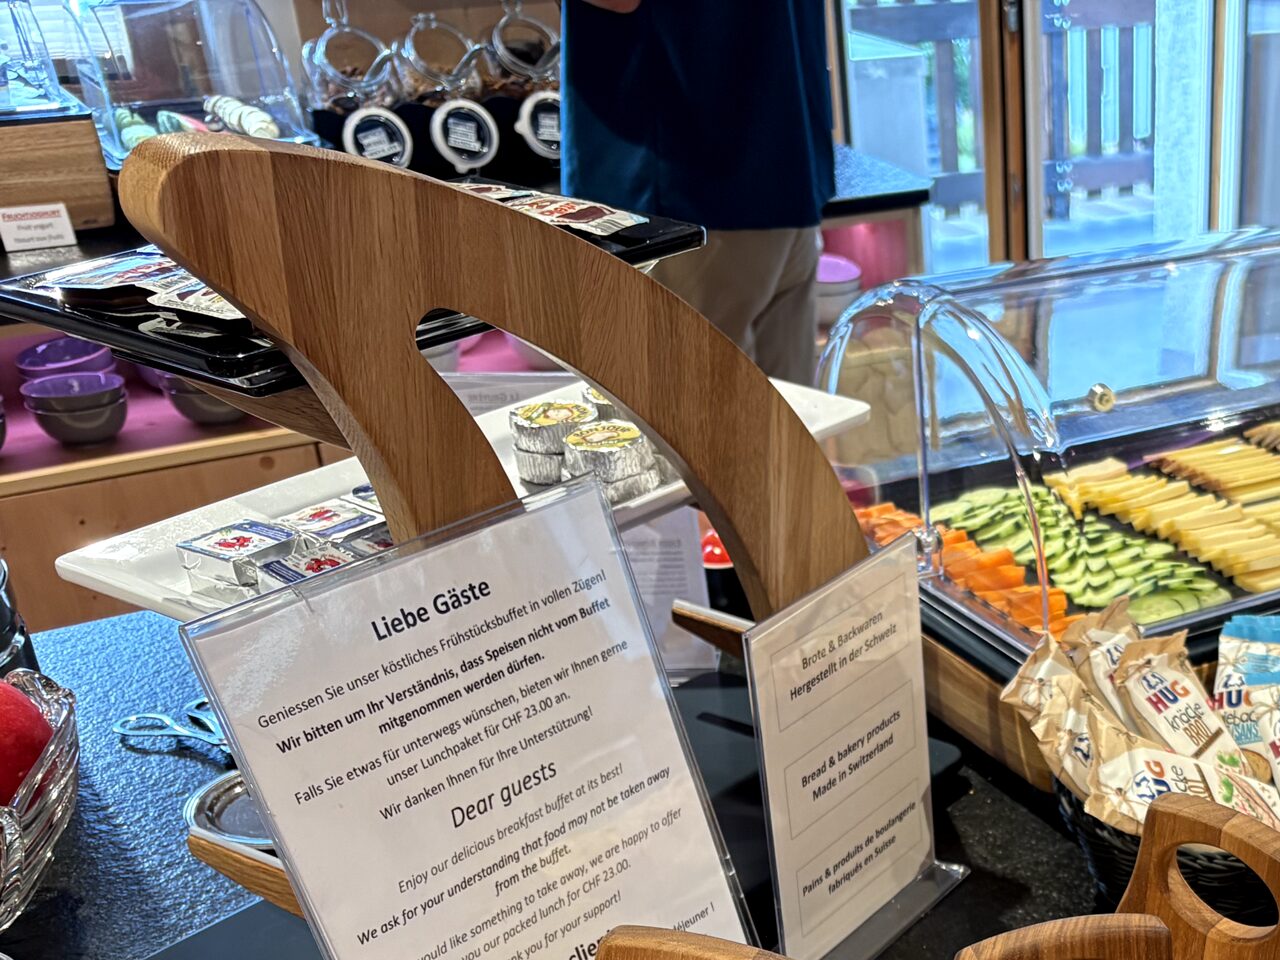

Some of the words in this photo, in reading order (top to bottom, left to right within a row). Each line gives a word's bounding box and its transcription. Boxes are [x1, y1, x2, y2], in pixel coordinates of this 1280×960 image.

[257, 694, 325, 729] Geniessen
[324, 685, 345, 701] Sie
[346, 669, 380, 692] unser
[380, 645, 439, 677] köstliches
[438, 604, 529, 652] Frühstücksbuffet
[528, 601, 541, 613] in
[540, 587, 572, 607] vollen
[571, 569, 607, 593] Zügen!
[370, 606, 431, 641] Liebe
[432, 581, 491, 615] Gäste
[801, 647, 827, 671] Brote
[828, 639, 837, 654] &
[837, 612, 883, 648] Backwaren
[275, 735, 301, 754] Wir
[302, 719, 344, 743] bitten
[344, 709, 366, 725] um
[366, 699, 385, 715] Ihr
[384, 668, 459, 705] Verständnis,
[459, 655, 485, 673] dass
[484, 636, 527, 662] Speisen
[527, 623, 555, 643] nicht
[554, 613, 579, 630] vom
[578, 598, 610, 619] Buffet
[378, 689, 463, 735] mitgenommen
[463, 669, 506, 695] werden
[506, 652, 545, 675] dürfen.
[789, 661, 838, 701] Hergestellt
[838, 656, 848, 669] in
[848, 645, 863, 663] der
[864, 623, 897, 652] Schweiz
[1146, 679, 1191, 715] HUG
[294, 784, 324, 805] Falls
[324, 775, 345, 791] Sie
[345, 757, 383, 781] etwas
[382, 747, 400, 764] für
[402, 720, 462, 755] unterwegs
[461, 694, 520, 726] wünschen,
[518, 676, 553, 699] bieten
[553, 667, 570, 682] wir
[570, 654, 600, 674] Ihnen
[600, 640, 628, 663] gerne
[379, 803, 402, 820] Wir
[404, 782, 446, 809] danken
[445, 766, 479, 788] Ihnen
[478, 756, 495, 772] für
[495, 745, 519, 763] Ihre
[518, 705, 593, 751] Unterstützung!
[386, 763, 419, 786] unser
[419, 731, 484, 770] Lunchpaket
[483, 723, 500, 739] für
[501, 710, 523, 730] CHF
[523, 696, 554, 720] 23.00
[554, 692, 571, 705] an.
[801, 760, 827, 788] Bread
[828, 755, 836, 769] &
[837, 736, 865, 762] bakery
[866, 710, 901, 744] products
[1183, 718, 1213, 747] BROT
[450, 793, 495, 829] Dear
[500, 762, 557, 808] guests
[812, 777, 837, 802] Made
[838, 770, 847, 783] in
[847, 732, 894, 776] Switzerland
[356, 928, 379, 945] We
[380, 914, 401, 934] ask
[401, 905, 419, 927] for
[419, 891, 445, 916] your
[447, 850, 521, 898] understanding
[521, 837, 544, 856] that
[543, 821, 567, 848] food
[567, 812, 588, 831] may
[589, 801, 606, 818] not
[606, 795, 619, 809] be
[619, 781, 646, 801] taken
[646, 767, 670, 786] away
[398, 870, 428, 894] Enjoy
[430, 859, 449, 877] our
[450, 834, 496, 866] delicious
[496, 807, 544, 841] breakfast
[544, 791, 575, 815] buffet
[575, 784, 587, 798] at
[587, 778, 599, 792] its
[599, 762, 623, 785] best!
[802, 874, 824, 897] Pains
[824, 867, 832, 880] &
[832, 843, 864, 876] produits
[864, 835, 875, 848] de
[874, 801, 916, 839] boulangerie
[828, 861, 864, 895] fabriqués
[863, 853, 874, 866] en
[874, 835, 897, 858] Suisse
[449, 932, 469, 950] like
[469, 900, 524, 939] something
[523, 894, 536, 907] to
[536, 880, 559, 899] take
[559, 864, 589, 886] away,
[588, 854, 604, 868] we
[604, 844, 621, 860] are
[620, 827, 649, 850] happy
[649, 821, 660, 833] to
[661, 807, 682, 827] offer
[483, 935, 501, 953] our
[502, 911, 538, 945] packed
[538, 896, 566, 921] lunch
[566, 888, 581, 907] for
[582, 873, 601, 894] CHF
[602, 858, 632, 883] 23.00.
[494, 873, 520, 898] from
[520, 863, 539, 879] the
[538, 844, 572, 869] buffet.
[523, 940, 543, 960] you
[544, 929, 559, 949] for
[559, 915, 582, 939] your
[582, 889, 622, 923] support!
